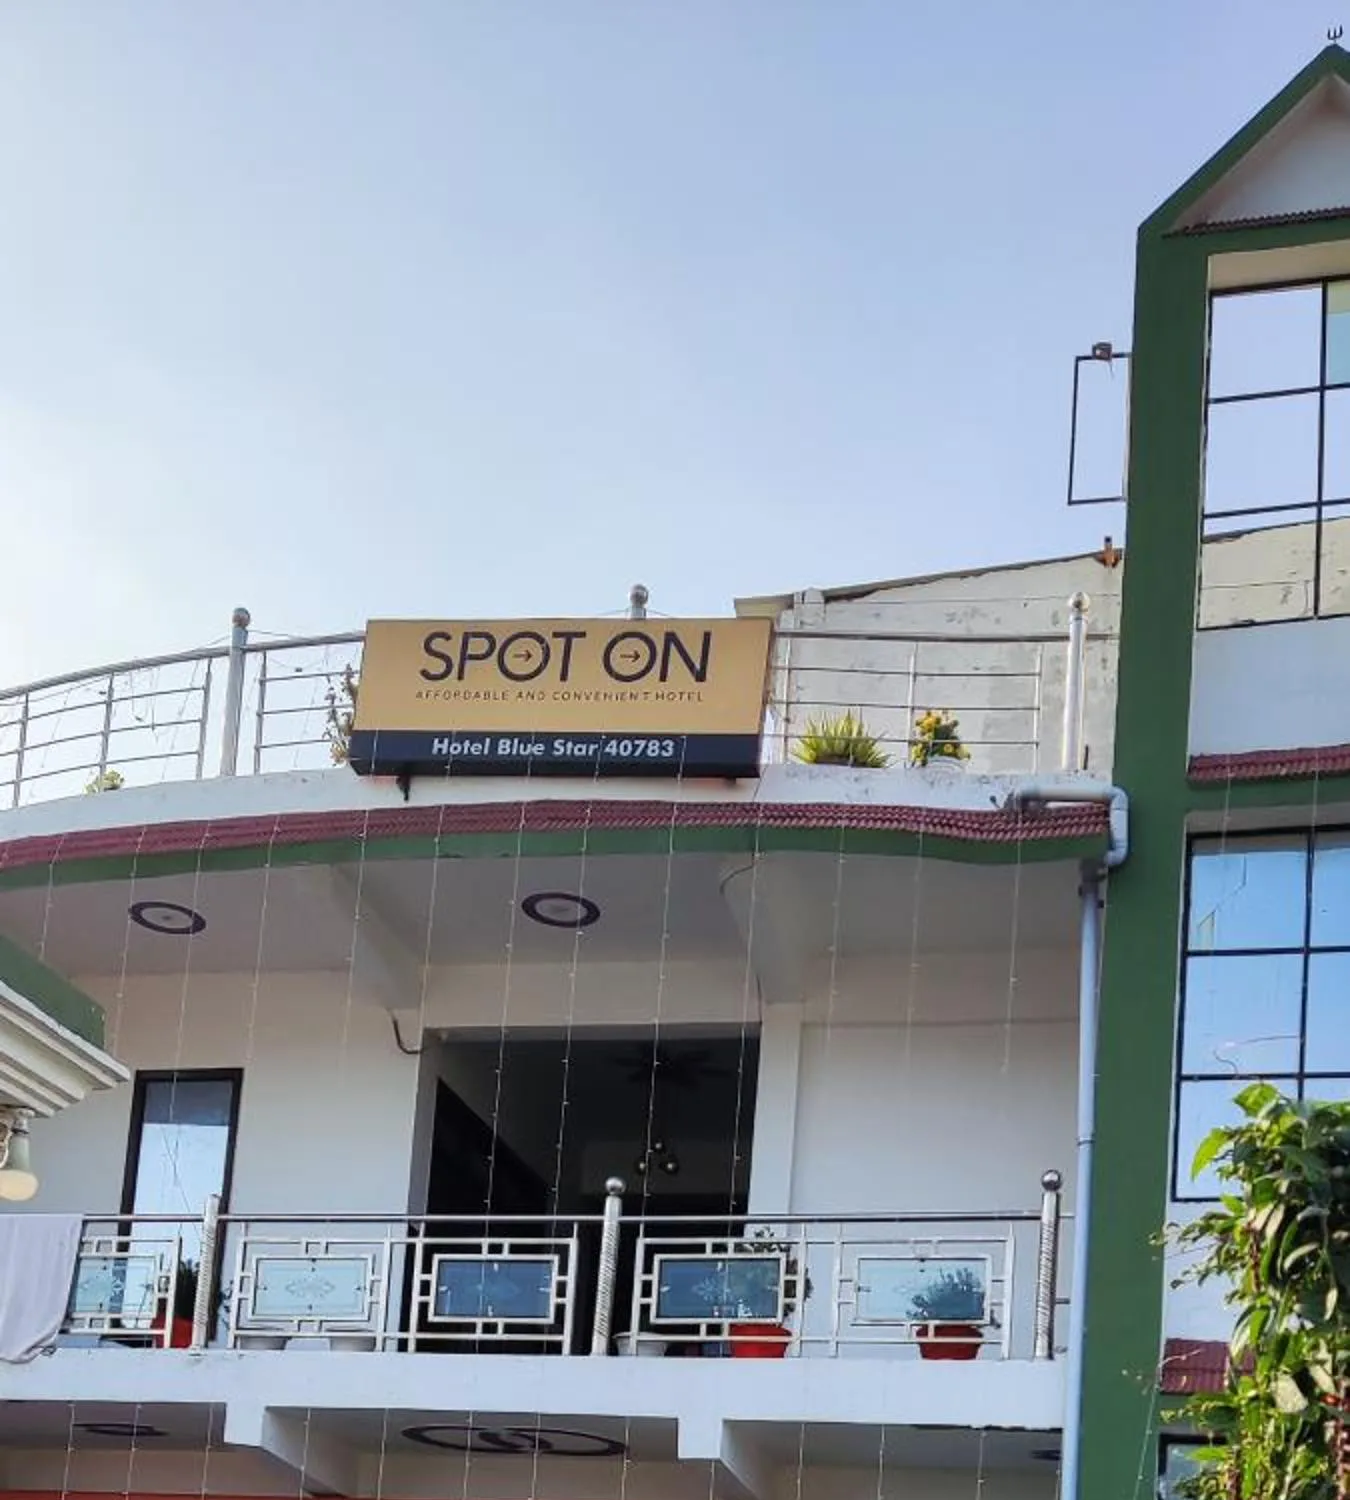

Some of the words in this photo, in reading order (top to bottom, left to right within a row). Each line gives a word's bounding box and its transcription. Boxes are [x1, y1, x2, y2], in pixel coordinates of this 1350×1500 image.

[420, 631, 586, 682] SPOT
[603, 631, 712, 683] ON
[415, 689, 509, 701] AFFORDABLE
[516, 690, 546, 701] AND
[552, 690, 651, 702] CONVENIENT
[655, 691, 704, 702] HOTEL
[431, 737, 490, 756] Hotel
[497, 737, 544, 756] Blue
[553, 738, 598, 757] Star
[604, 738, 674, 757] 40783
